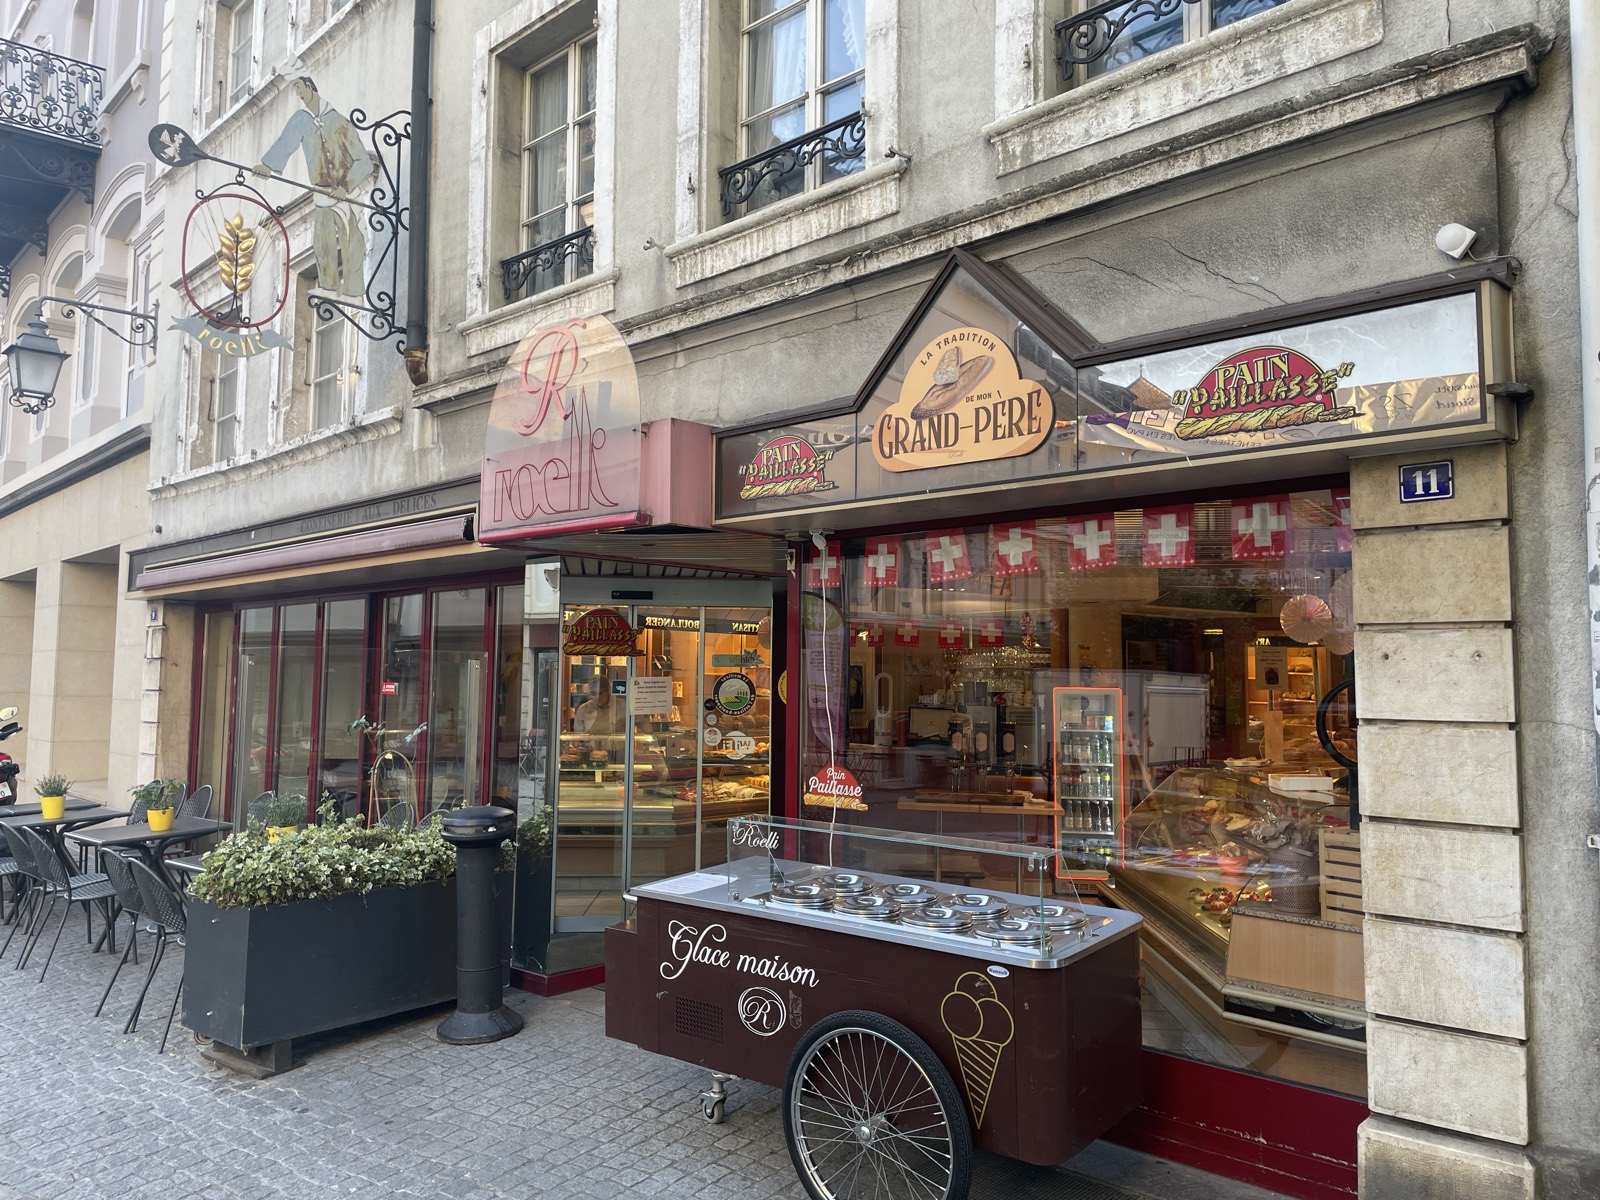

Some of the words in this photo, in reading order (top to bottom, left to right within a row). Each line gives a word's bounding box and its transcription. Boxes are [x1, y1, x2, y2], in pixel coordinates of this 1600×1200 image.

[197, 328, 271, 356] roelli
[920, 353, 934, 366] LA
[935, 332, 997, 352] TRADITION
[512, 317, 587, 437] R
[1214, 352, 1291, 391] PAIN
[965, 395, 975, 403] DE
[976, 391, 992, 402] MON
[878, 387, 1042, 459] GRAND-PÈRE
[493, 385, 619, 523] roelli
[761, 440, 802, 466] PAIN
[1412, 468, 1440, 495] 11
[808, 776, 864, 797] Paillasse
[826, 767, 846, 780] Pain
[732, 824, 780, 850] Roelli
[660, 919, 731, 980] Glace
[736, 954, 820, 988] maison
